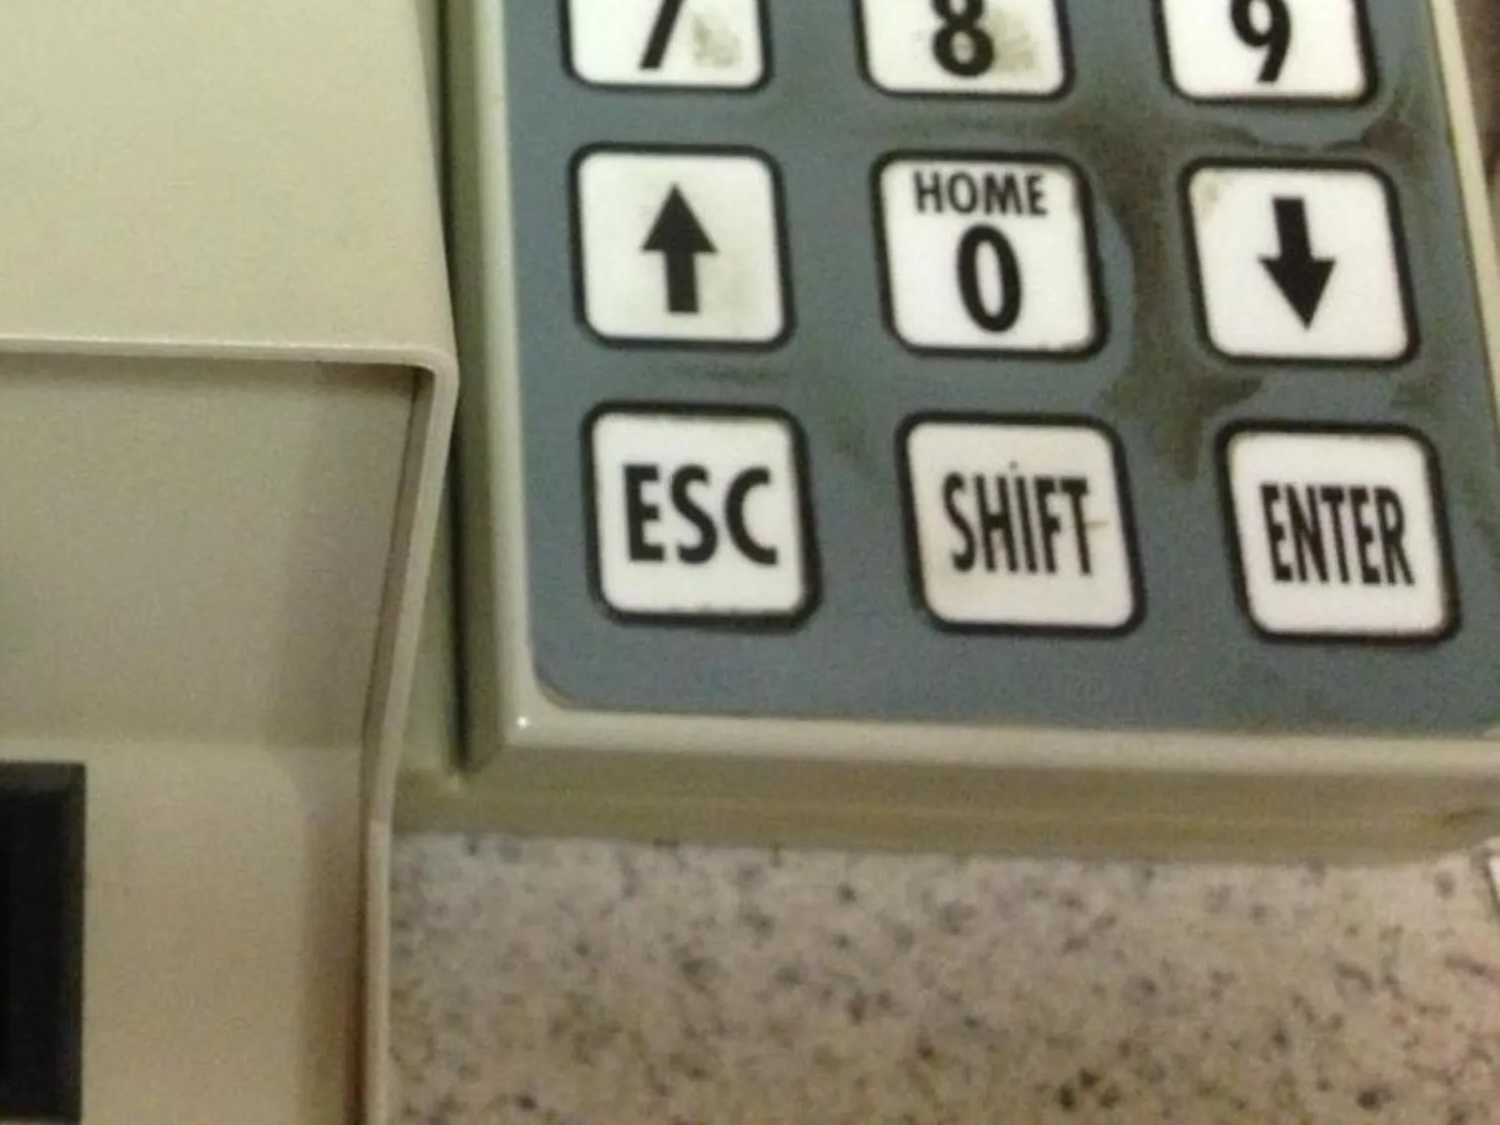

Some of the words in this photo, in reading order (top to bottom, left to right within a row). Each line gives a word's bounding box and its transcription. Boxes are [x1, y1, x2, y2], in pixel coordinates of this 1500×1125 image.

[912, 170, 1048, 217] HOME
[954, 222, 1024, 335] 0
[622, 462, 780, 568] ESC
[940, 471, 1094, 576] SHIFT
[1258, 482, 1416, 587] ENTER
